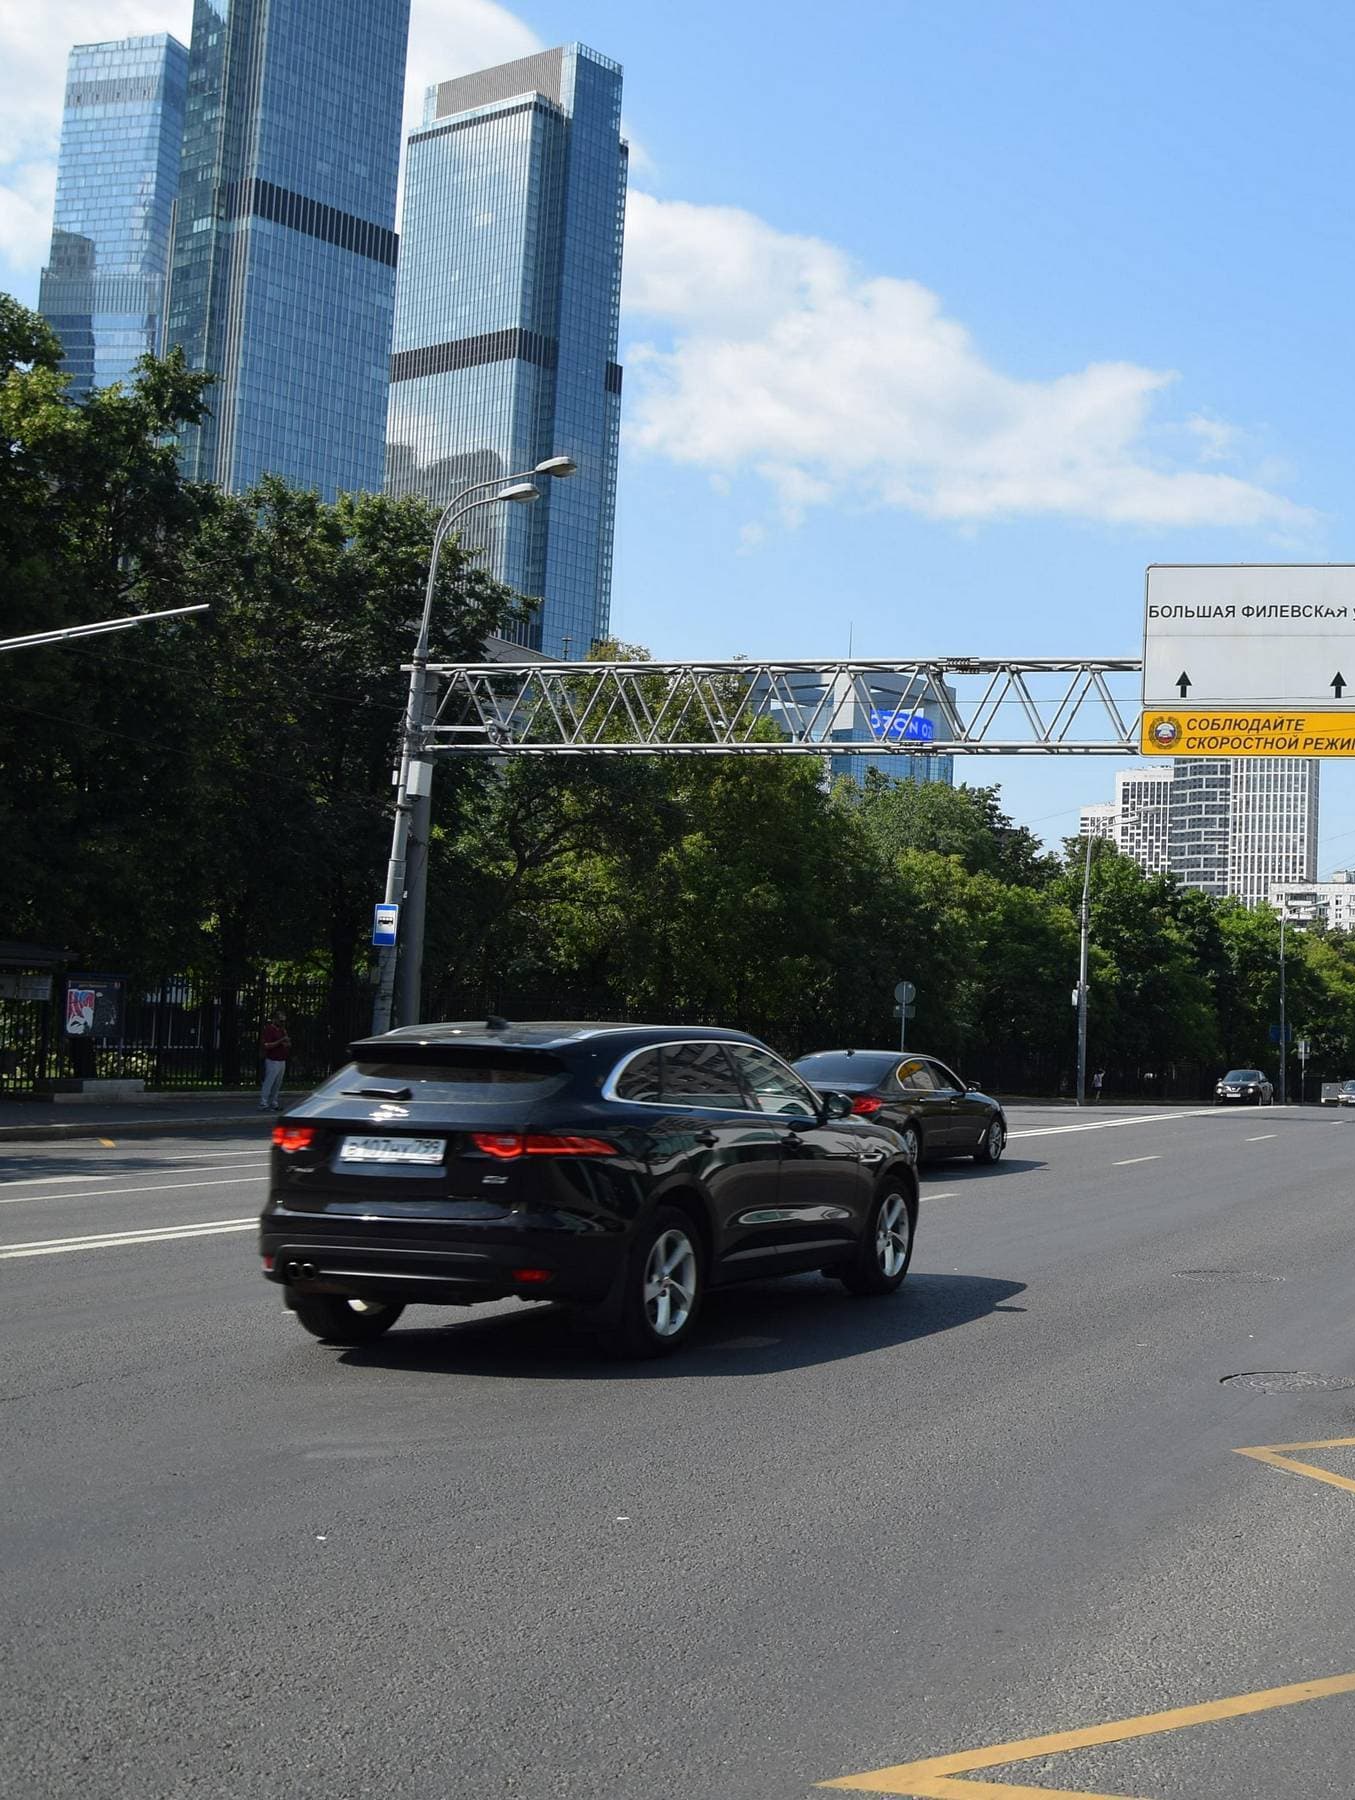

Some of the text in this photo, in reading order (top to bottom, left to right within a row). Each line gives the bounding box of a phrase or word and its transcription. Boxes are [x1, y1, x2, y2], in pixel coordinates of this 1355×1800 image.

[1149, 605, 1235, 618] БОЛЬШАЯ
[1242, 605, 1348, 618] ФИЛЕВСКАЯ
[1186, 716, 1306, 733] СОБЛЮДАЙТЕ
[1186, 735, 1299, 750] СКОРОСТНОЙ
